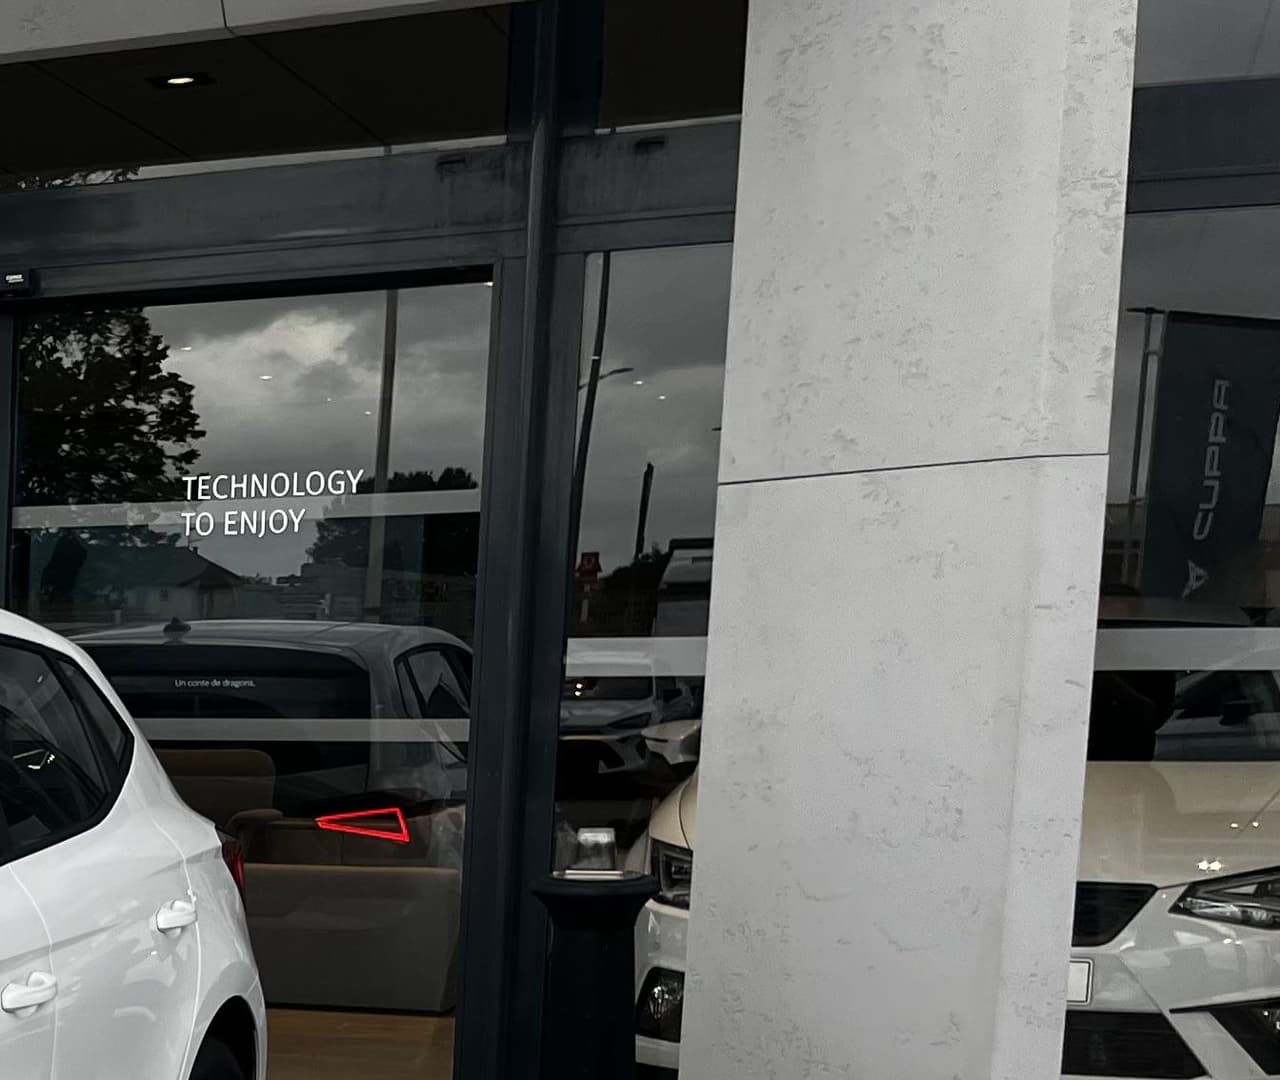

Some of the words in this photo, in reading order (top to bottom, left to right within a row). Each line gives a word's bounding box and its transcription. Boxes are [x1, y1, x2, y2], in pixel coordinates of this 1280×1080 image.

[182, 469, 364, 500] TECHNOLOGY
[181, 512, 215, 537] TO
[224, 508, 306, 538] ENJOY
